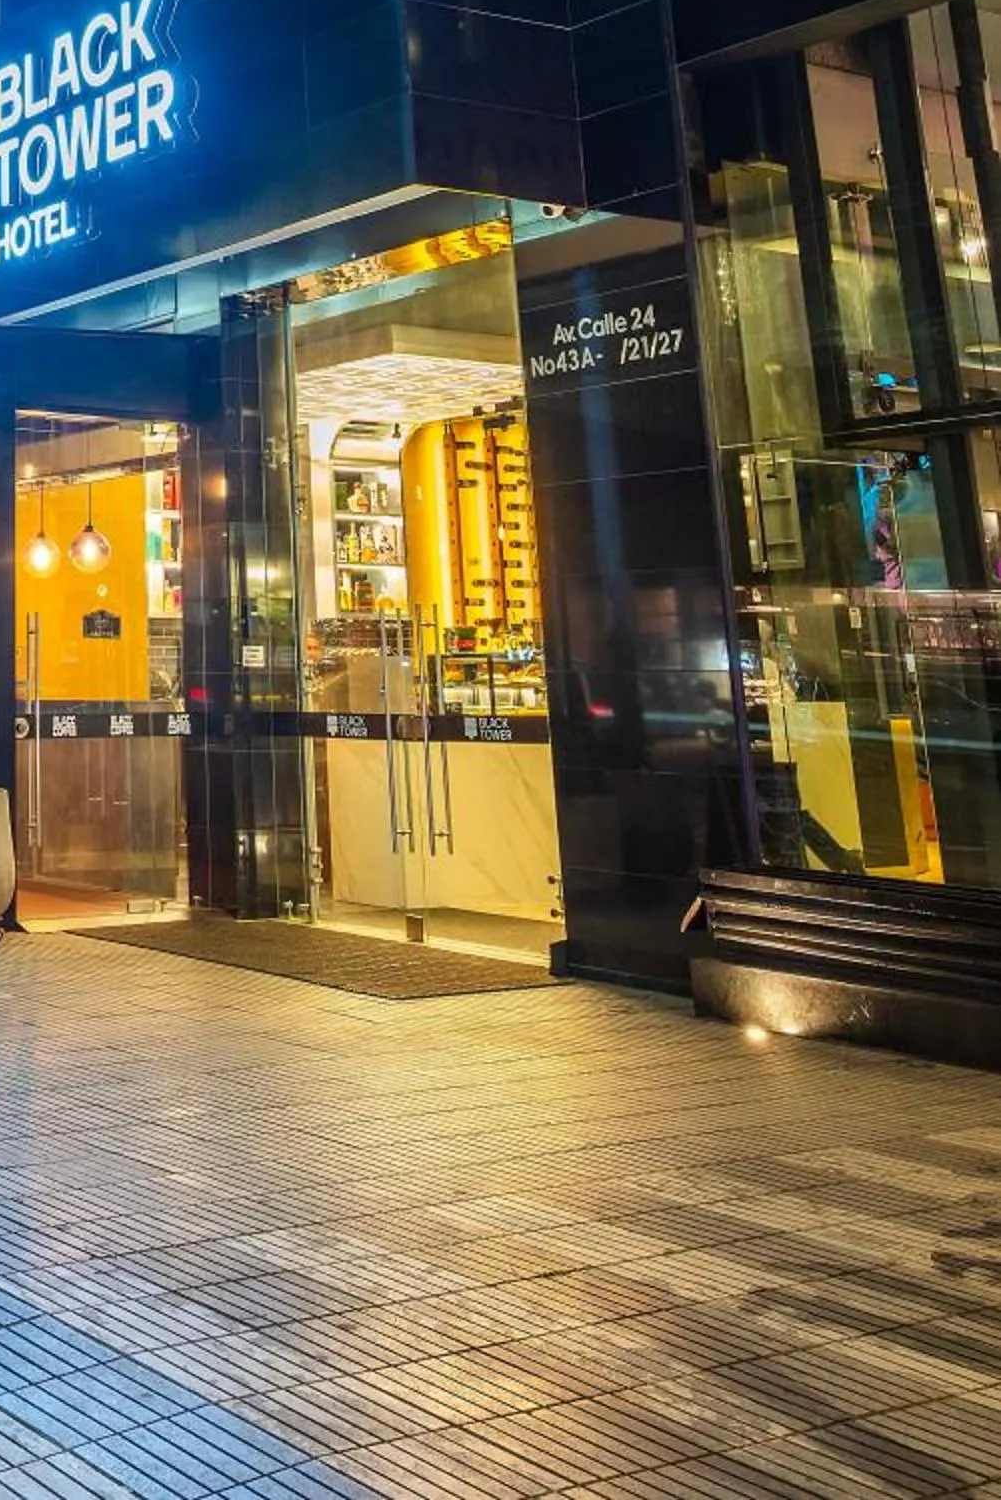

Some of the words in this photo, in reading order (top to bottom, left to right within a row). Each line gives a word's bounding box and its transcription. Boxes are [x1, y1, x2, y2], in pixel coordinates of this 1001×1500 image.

[577, 312, 628, 340] Calle
[630, 303, 656, 331] 24
[338, 715, 366, 726] BLACK
[478, 717, 509, 729] BLACK
[479, 729, 512, 741] TOWER
